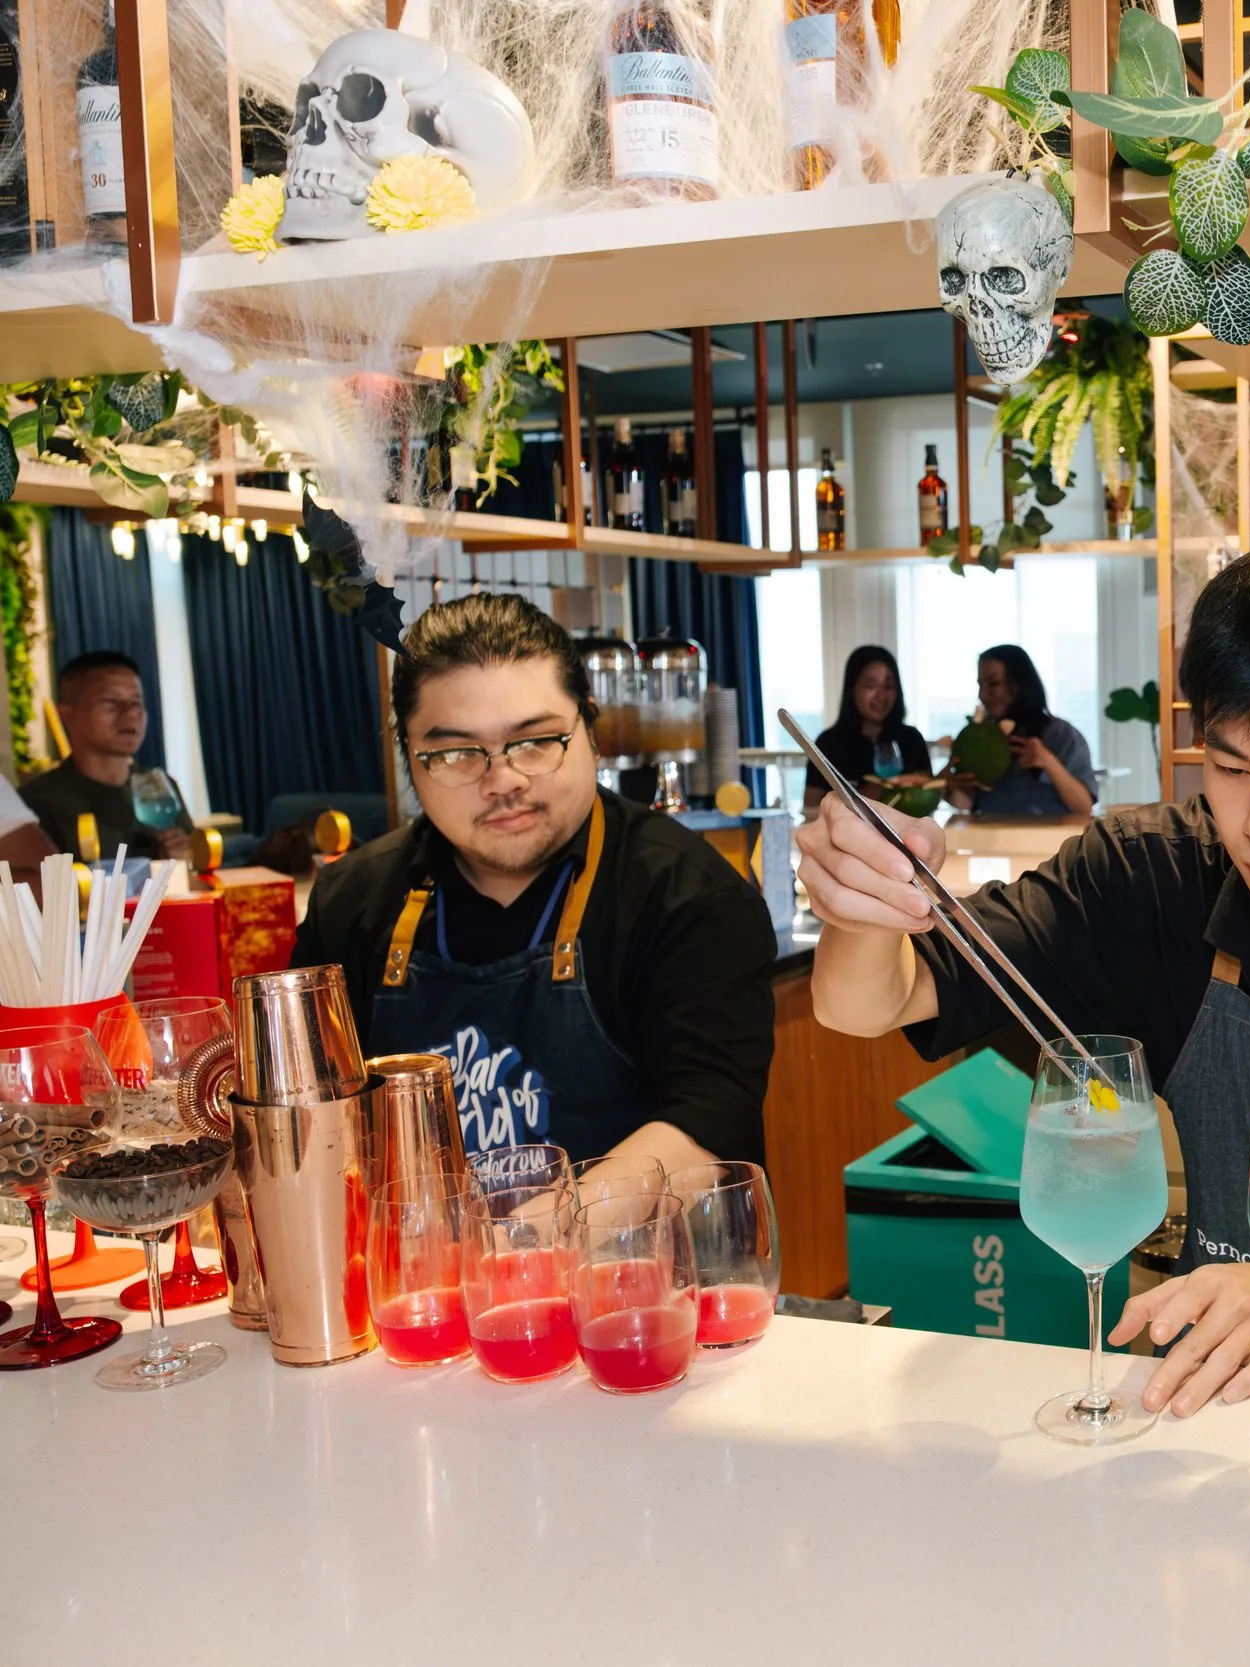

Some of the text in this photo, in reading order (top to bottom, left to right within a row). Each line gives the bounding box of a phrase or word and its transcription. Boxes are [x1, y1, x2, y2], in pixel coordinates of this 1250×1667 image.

[661, 130, 680, 149] 15
[91, 173, 107, 187] 30
[512, 1071, 542, 1128] of
